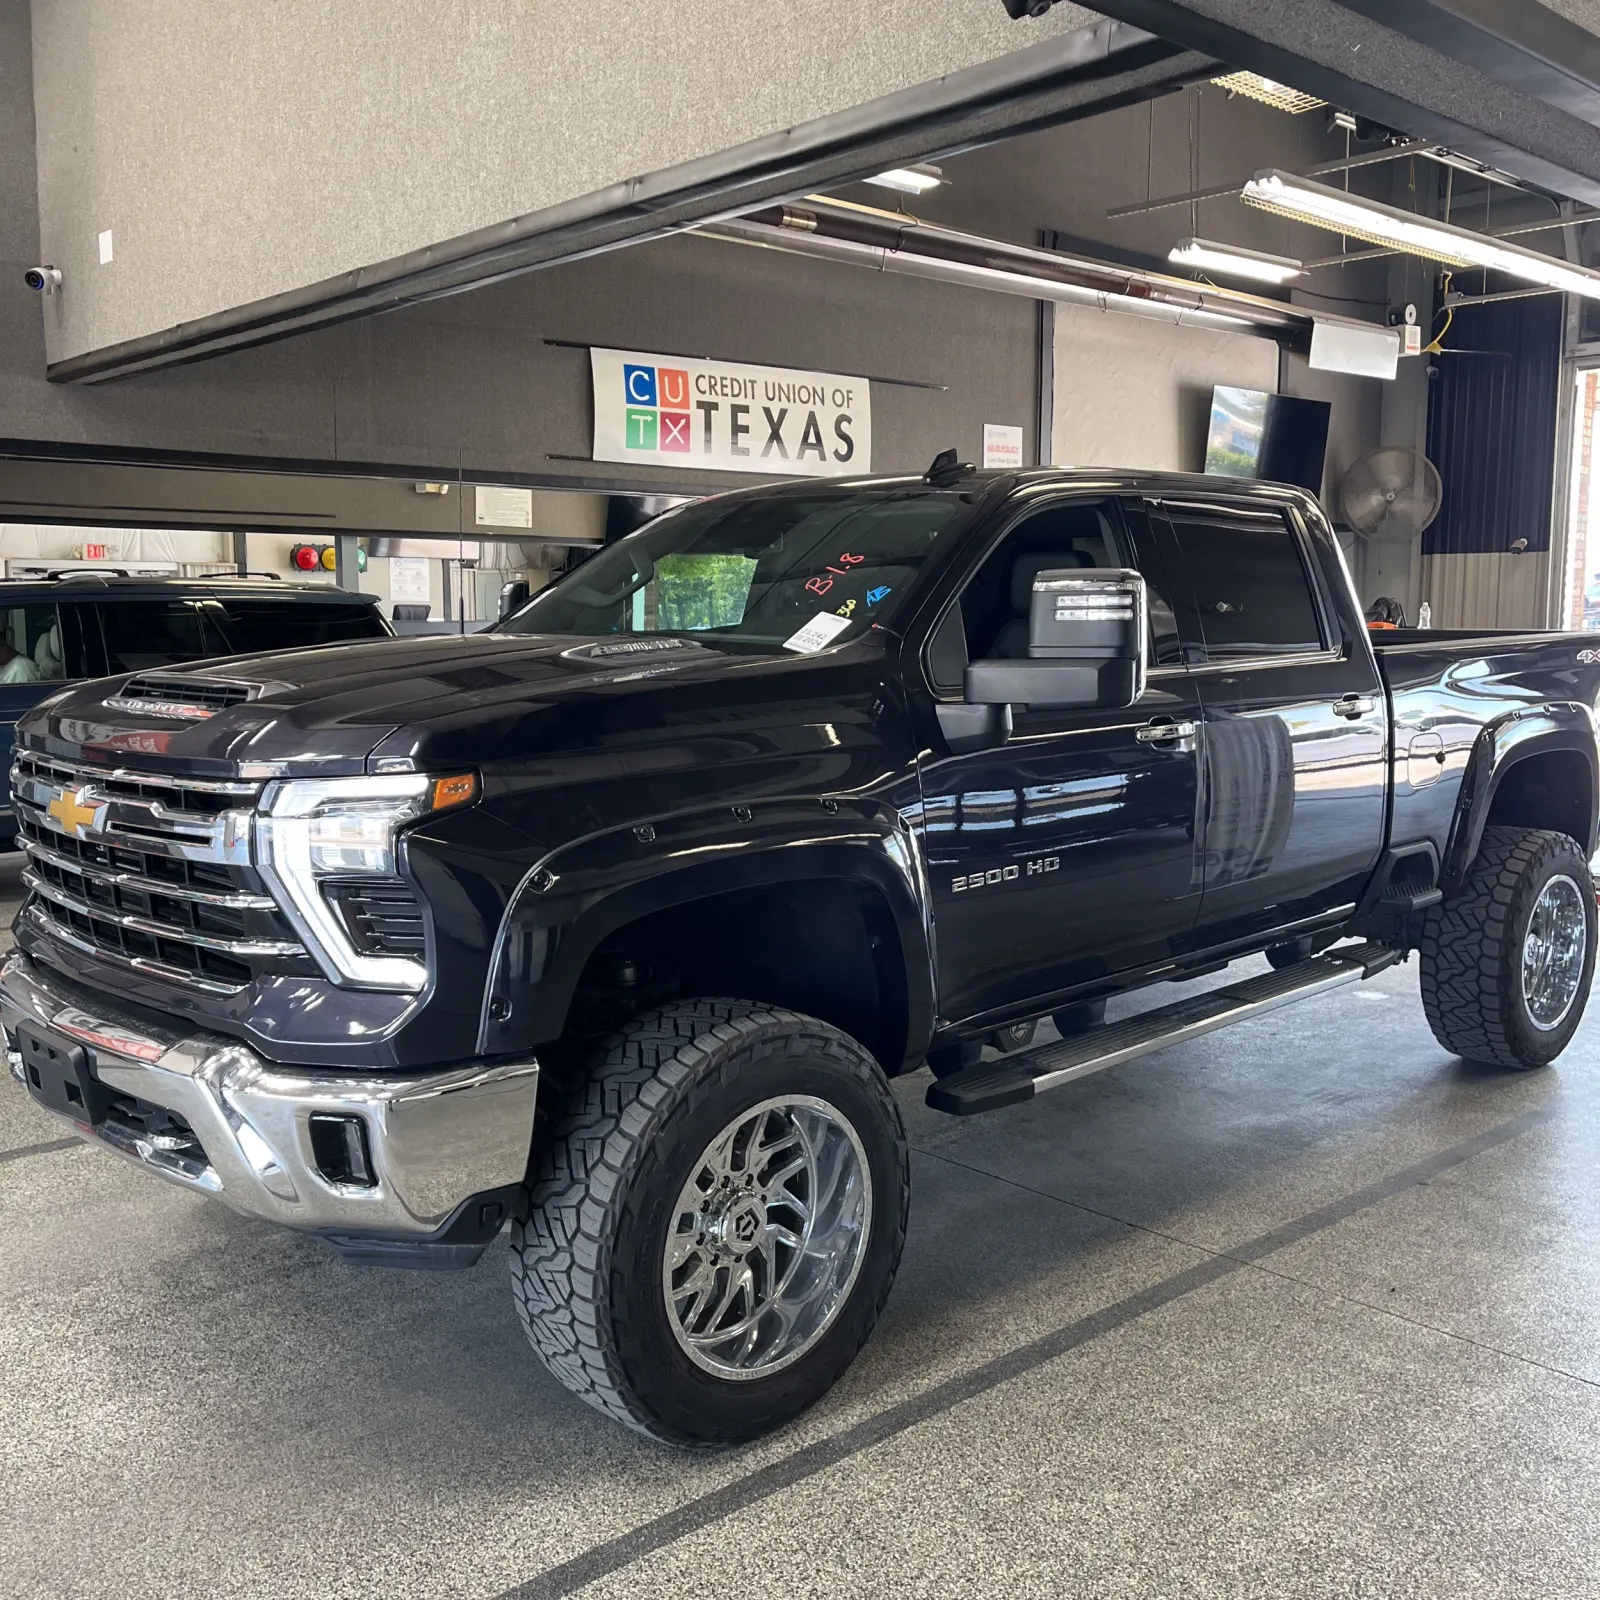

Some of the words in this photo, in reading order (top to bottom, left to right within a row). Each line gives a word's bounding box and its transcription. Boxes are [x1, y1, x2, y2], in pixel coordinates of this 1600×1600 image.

[695, 374, 756, 400] CREDIT
[764, 381, 825, 407] UNION
[832, 388, 853, 408] OF
[696, 399, 854, 463] TEXAS
[87, 543, 106, 559] EXIT
[951, 864, 1019, 893] 2500
[1026, 856, 1060, 876] HD
